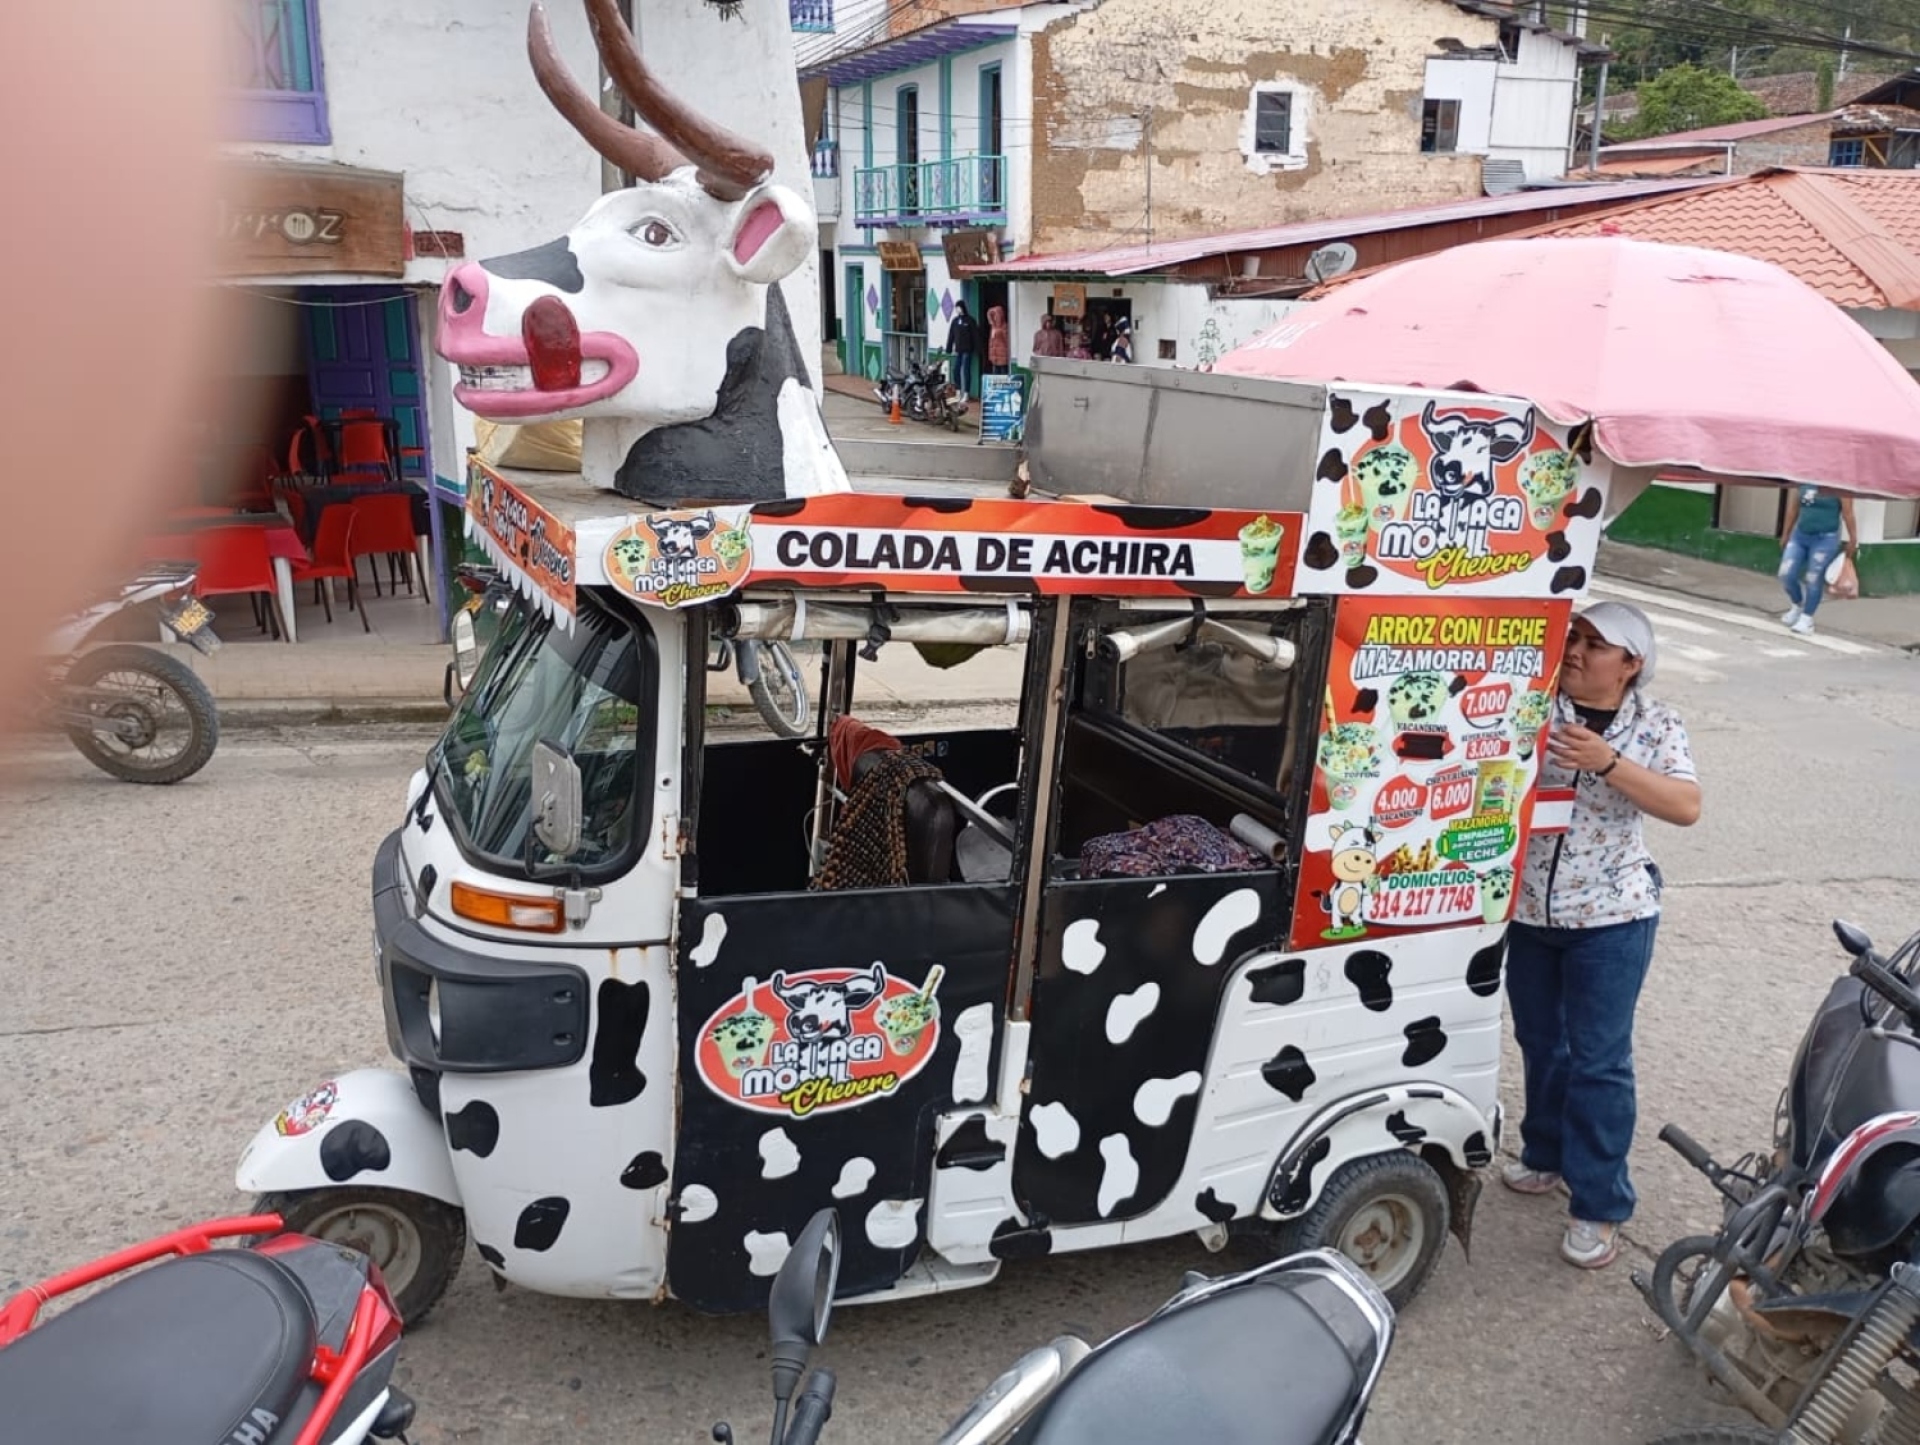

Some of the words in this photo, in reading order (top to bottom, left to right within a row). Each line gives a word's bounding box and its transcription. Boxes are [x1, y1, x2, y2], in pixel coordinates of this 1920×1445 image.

[1413, 492, 1441, 521] LA
[651, 558, 667, 573] LA
[776, 529, 963, 571] COLADA
[975, 537, 1034, 573] DE
[1043, 538, 1195, 577] ACHIRA
[1416, 547, 1531, 589] Chevere
[1364, 616, 1437, 646] ARROZ
[1439, 616, 1484, 647] CON
[1485, 617, 1548, 647] LECHE
[1354, 647, 1487, 680] MAZAMORRA
[1490, 647, 1545, 677] PAISA
[1465, 690, 1507, 717] 7.000
[1468, 740, 1501, 759] 3.000
[1378, 787, 1418, 811] 4.000
[1431, 782, 1470, 810] 6.000
[1450, 814, 1510, 830] MAZAMORRA
[1459, 847, 1499, 861] LECHE
[1388, 870, 1477, 889] DOMICILIOS
[1369, 891, 1400, 920] 314
[1404, 888, 1435, 917] 217
[1437, 885, 1476, 914] 7748
[773, 1043, 800, 1064] LA
[779, 1071, 899, 1115] Chevere
